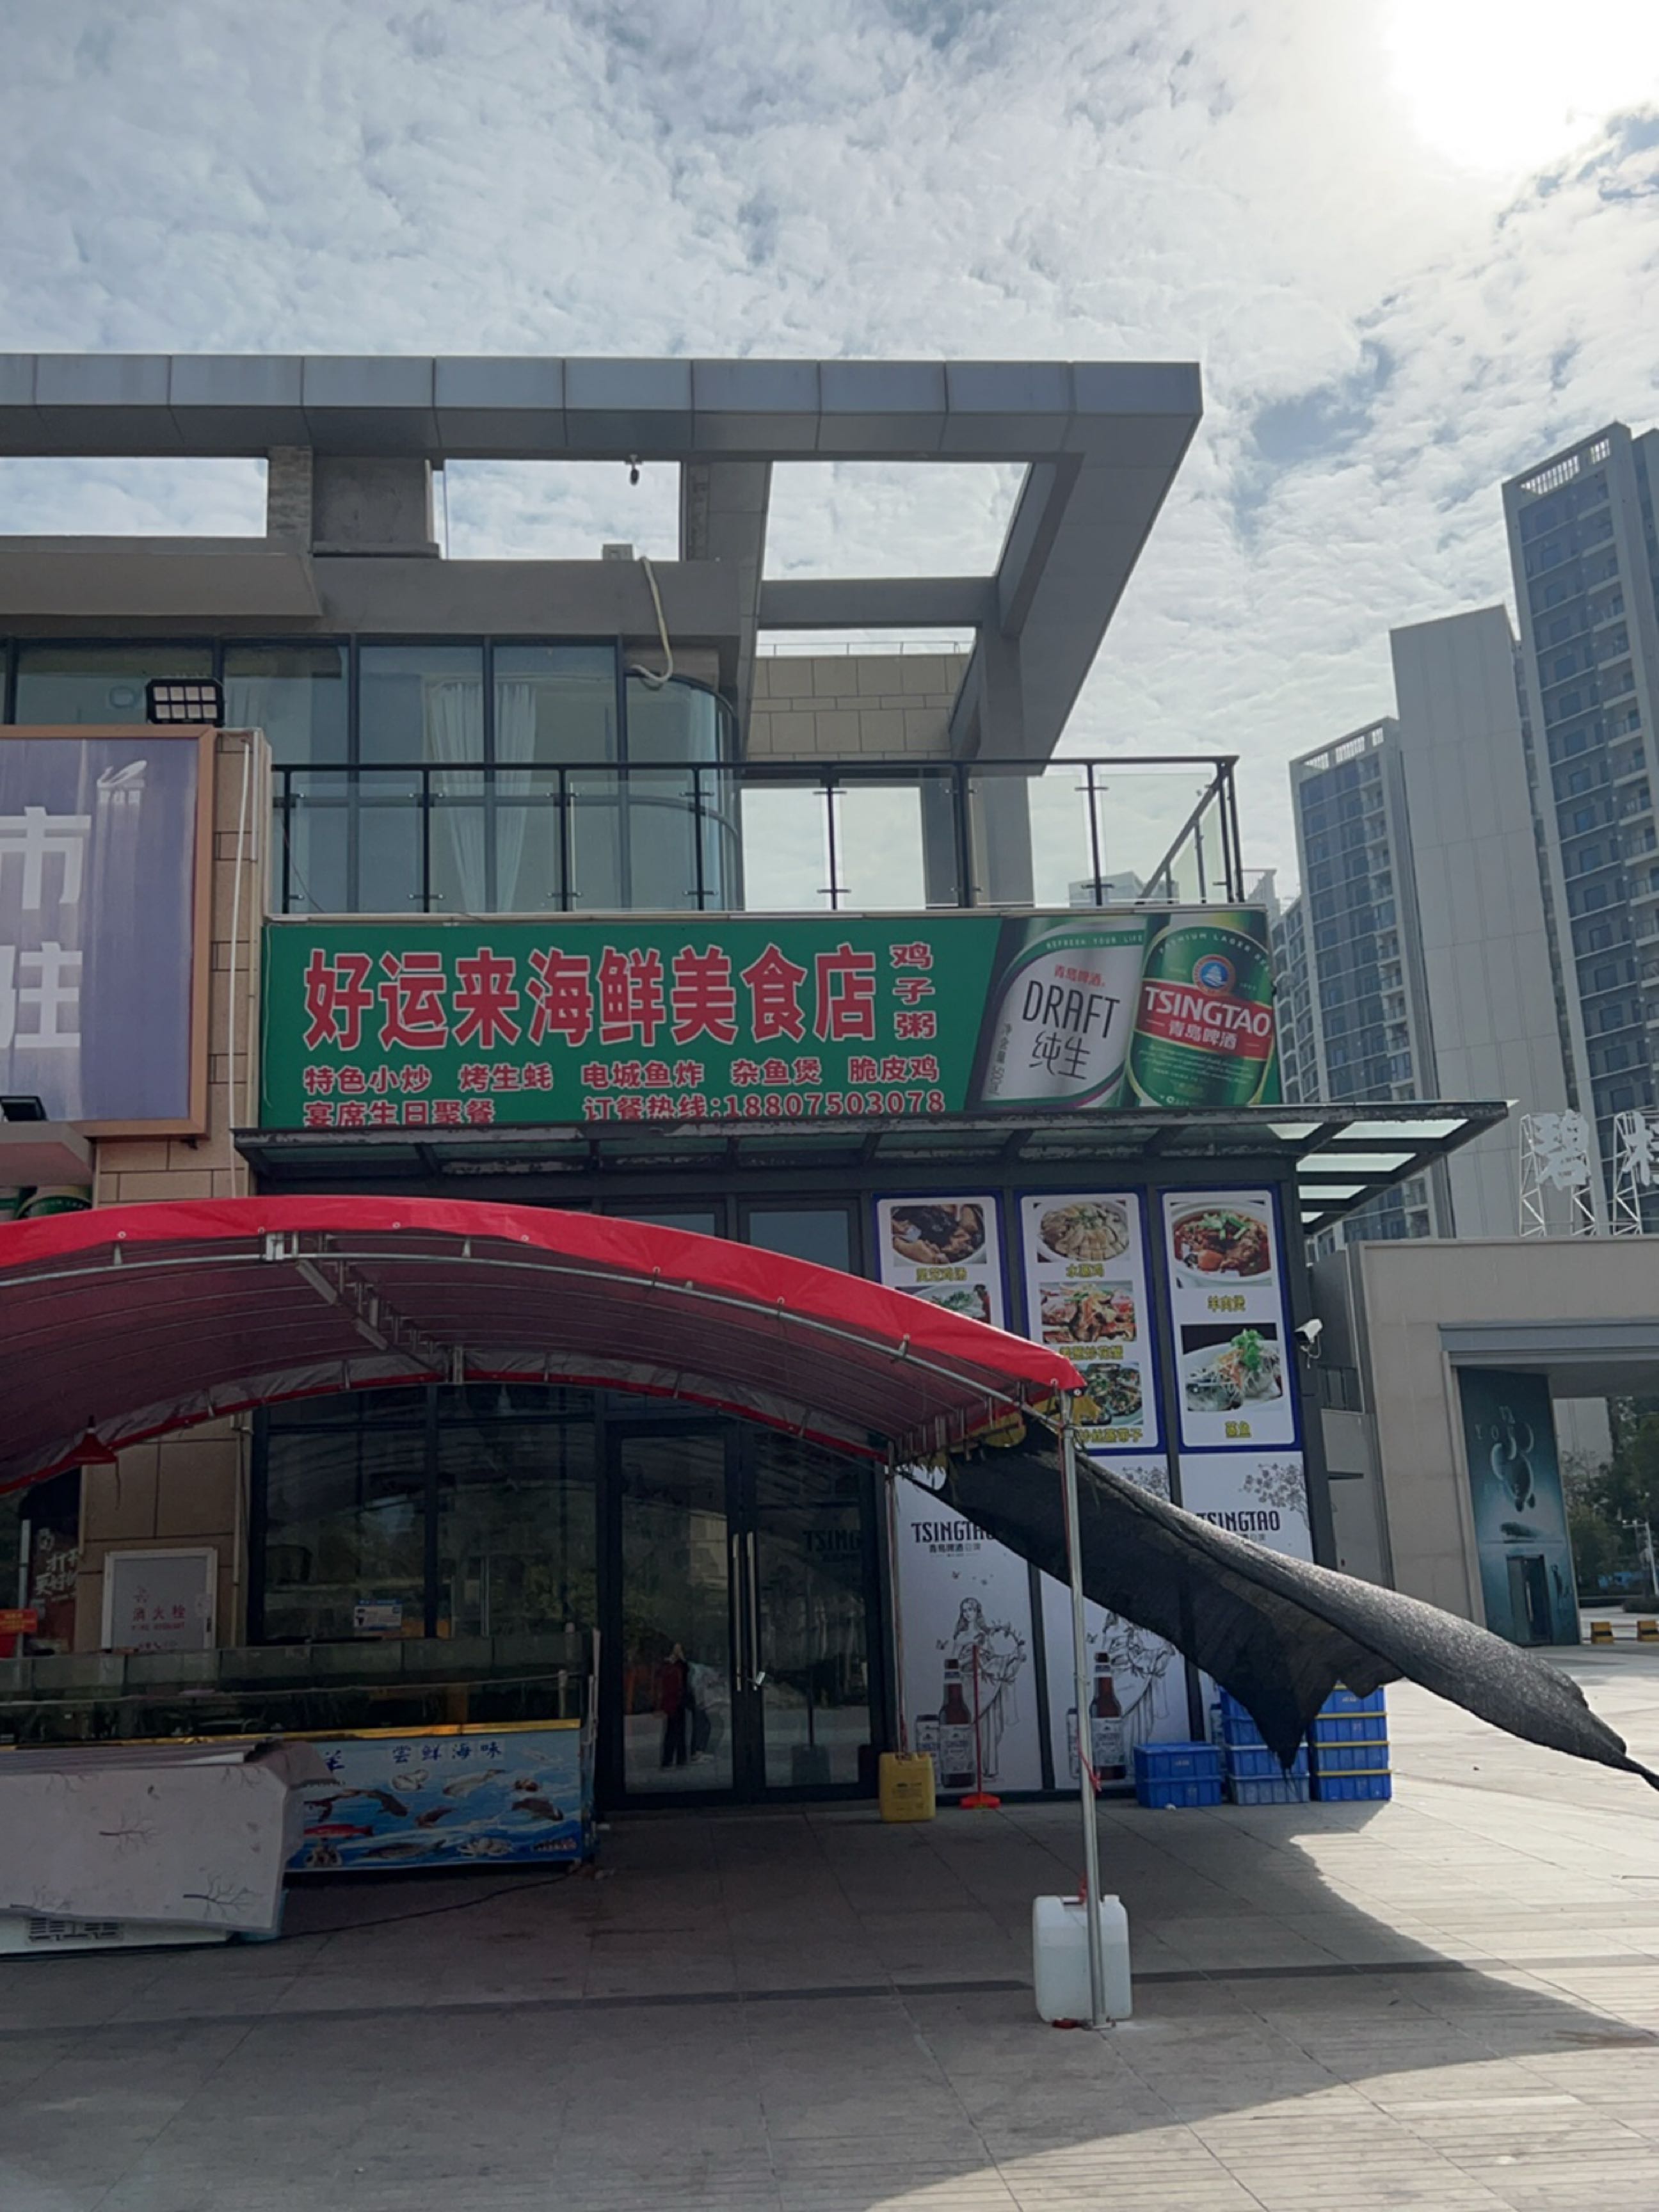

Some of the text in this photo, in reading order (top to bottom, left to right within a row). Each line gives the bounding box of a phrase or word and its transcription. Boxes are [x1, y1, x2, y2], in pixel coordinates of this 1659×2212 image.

[1214, 934, 1251, 952] LAGER
[303, 942, 876, 1051] 好运来海鲜美食店
[890, 942, 937, 1039] 鸡子粥
[1022, 980, 1120, 1039] DRAFT
[1144, 986, 1271, 1038] TSINGTAO
[1029, 1029, 1090, 1080] 纯生
[1169, 1020, 1238, 1050] 青岛啤酒
[303, 1054, 940, 1096] 特色小炒 烤生蚝 电城鱼炸 杂鱼煲 脆皮鸡
[303, 1099, 495, 1128] 宴席生日聚餐
[133, 1603, 186, 1620] 消火栓
